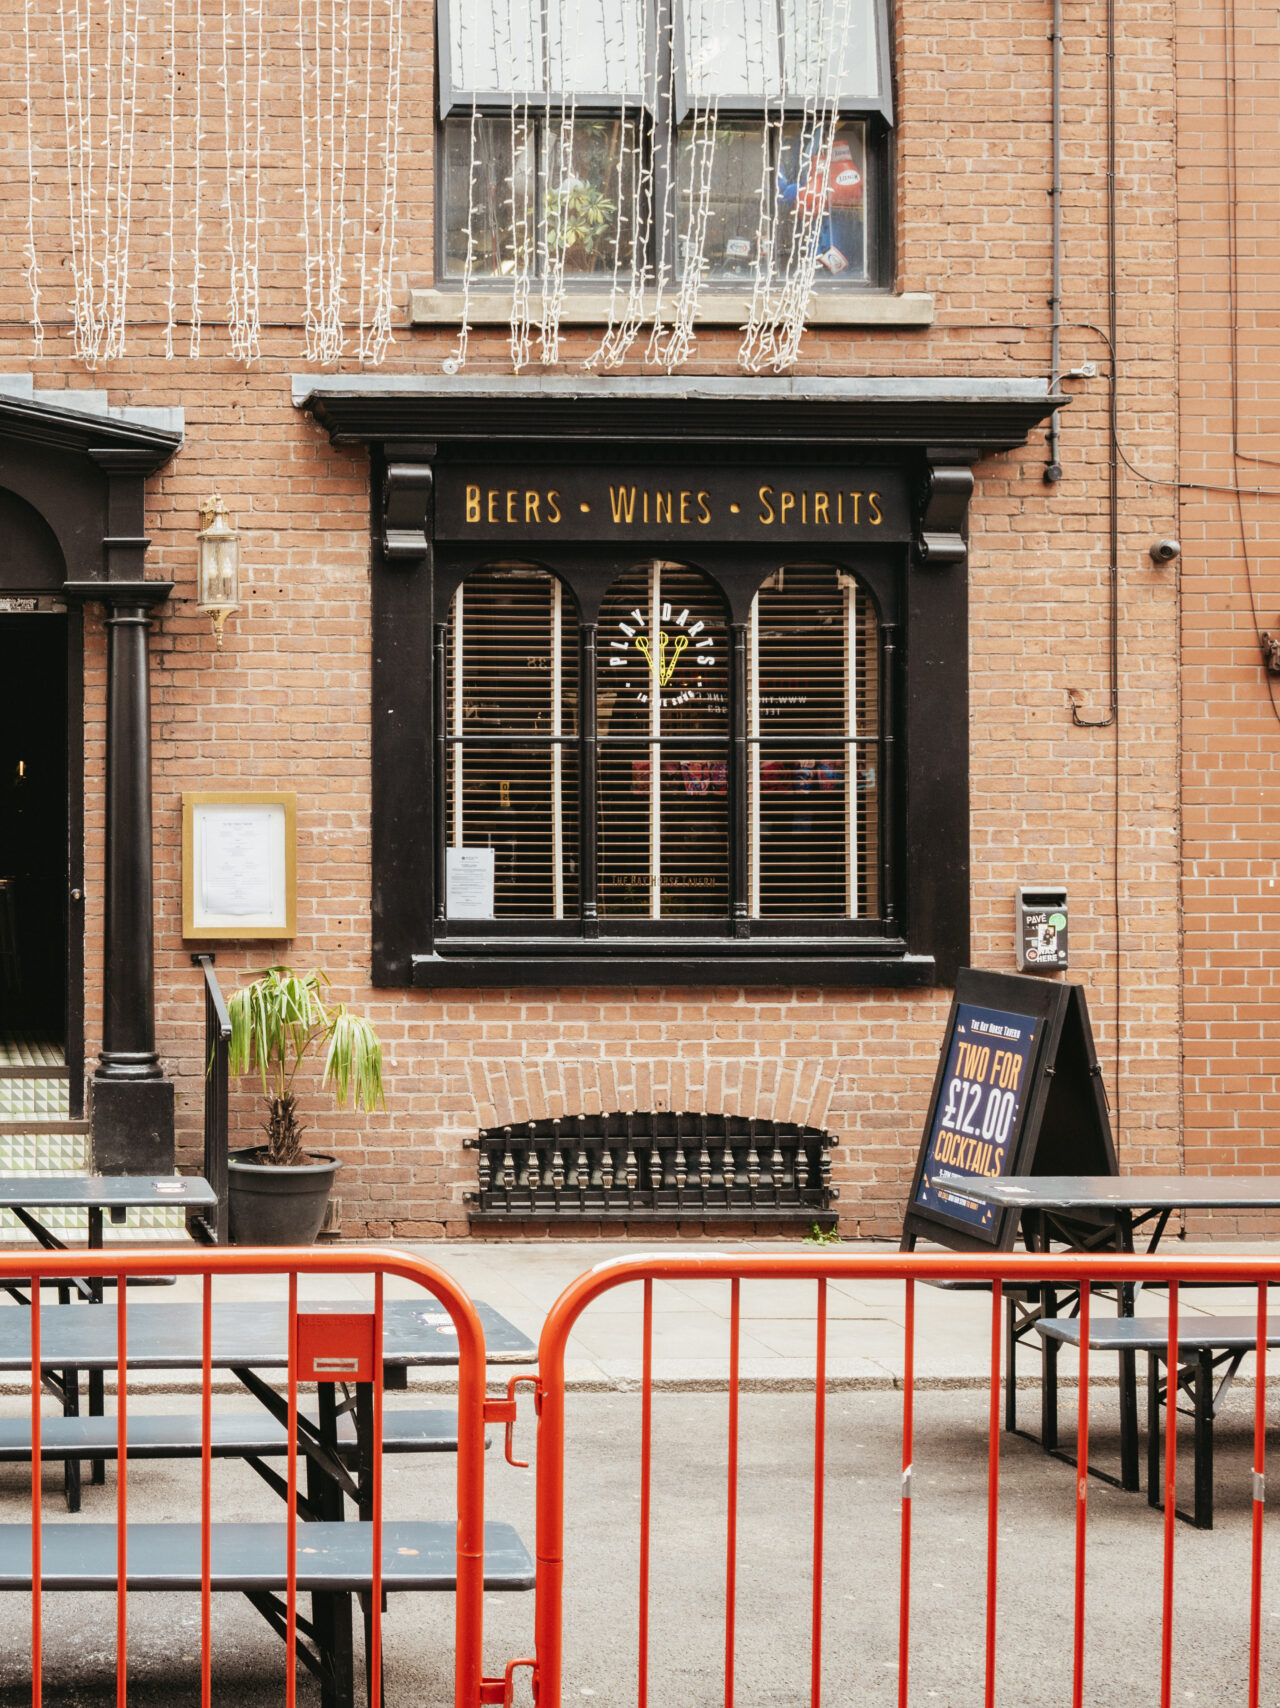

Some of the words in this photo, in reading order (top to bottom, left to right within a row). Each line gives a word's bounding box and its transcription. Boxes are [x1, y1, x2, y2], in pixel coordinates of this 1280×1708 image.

[465, 484, 562, 524] BEERS
[609, 484, 712, 524] WINES
[758, 484, 885, 526] SPIRITS
[608, 607, 646, 667] PLAY
[662, 602, 716, 667] DARTS
[954, 1041, 991, 1083] TWO
[989, 1049, 1023, 1092] FOR
[941, 1078, 1016, 1144] £12.00
[934, 1130, 1005, 1178] COCKTAILS
